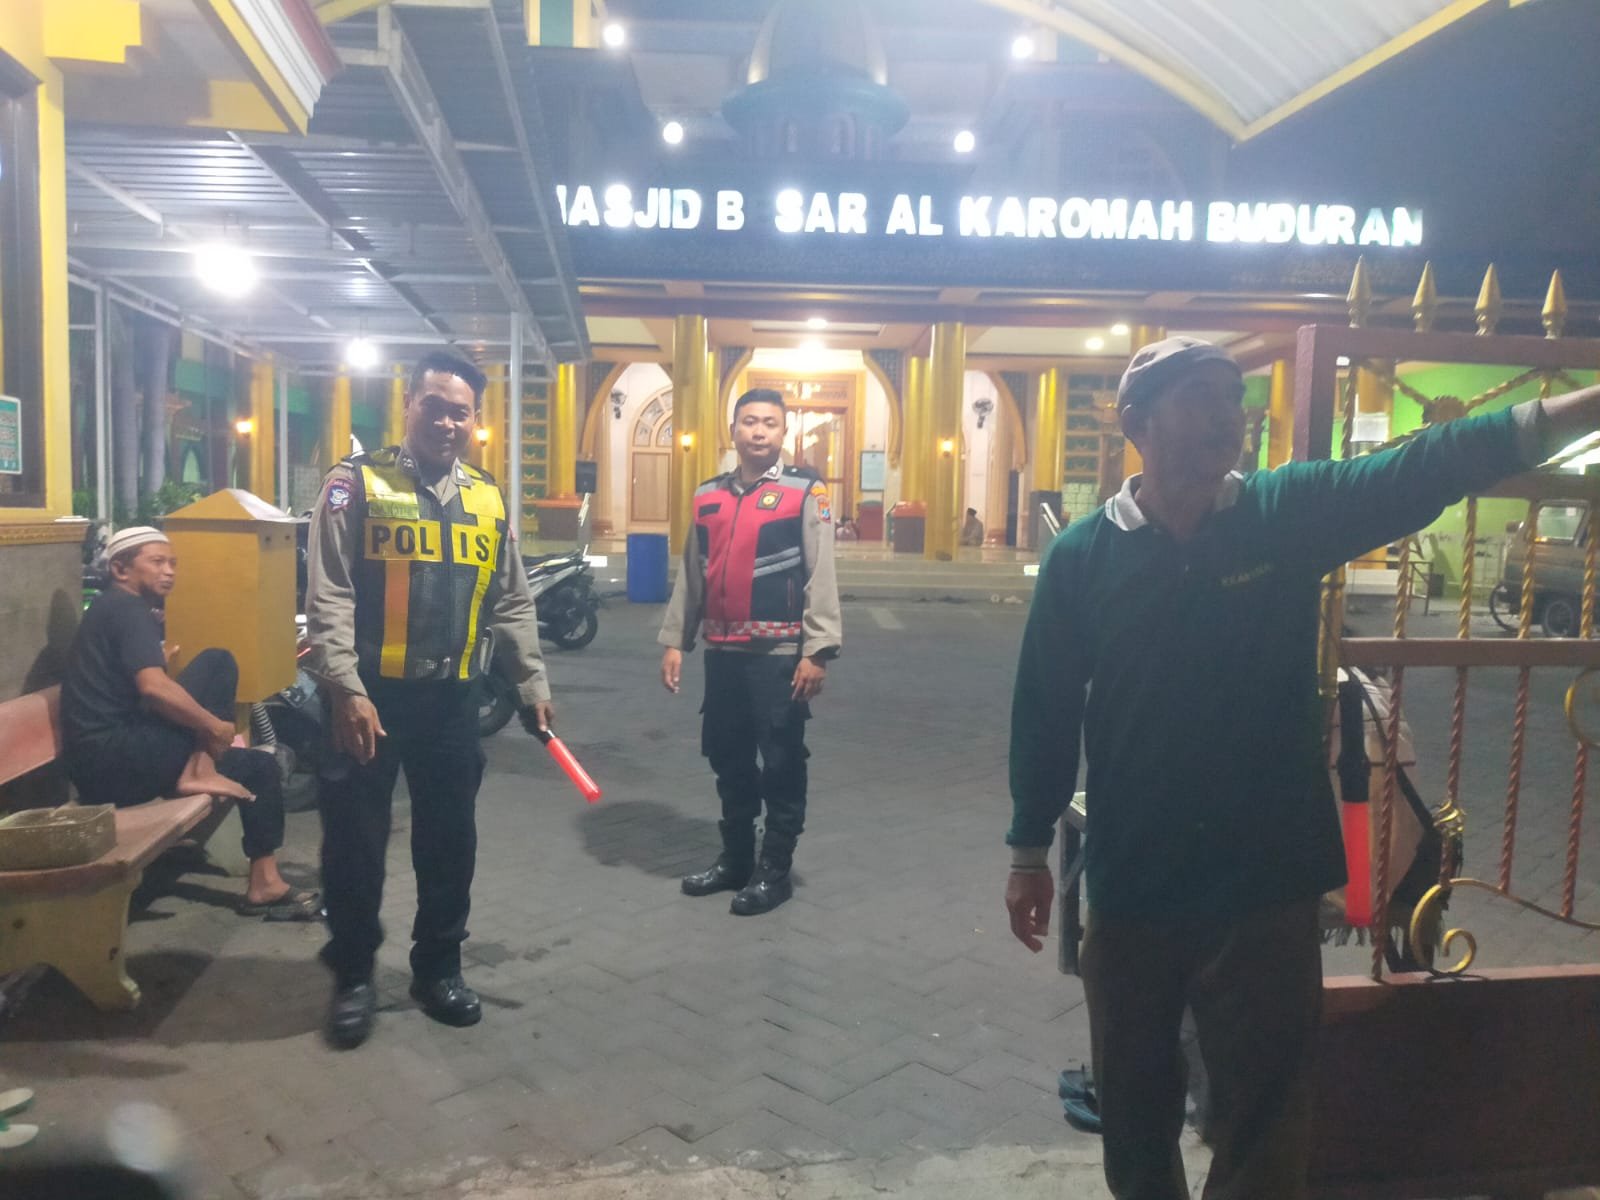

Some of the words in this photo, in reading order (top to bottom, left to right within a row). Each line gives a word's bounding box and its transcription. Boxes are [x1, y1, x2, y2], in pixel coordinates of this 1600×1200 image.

[556, 184, 702, 229] ASJID
[885, 194, 944, 236] AL
[958, 196, 1194, 241] KAROMAH
[1206, 201, 1424, 247] BUDURAN
